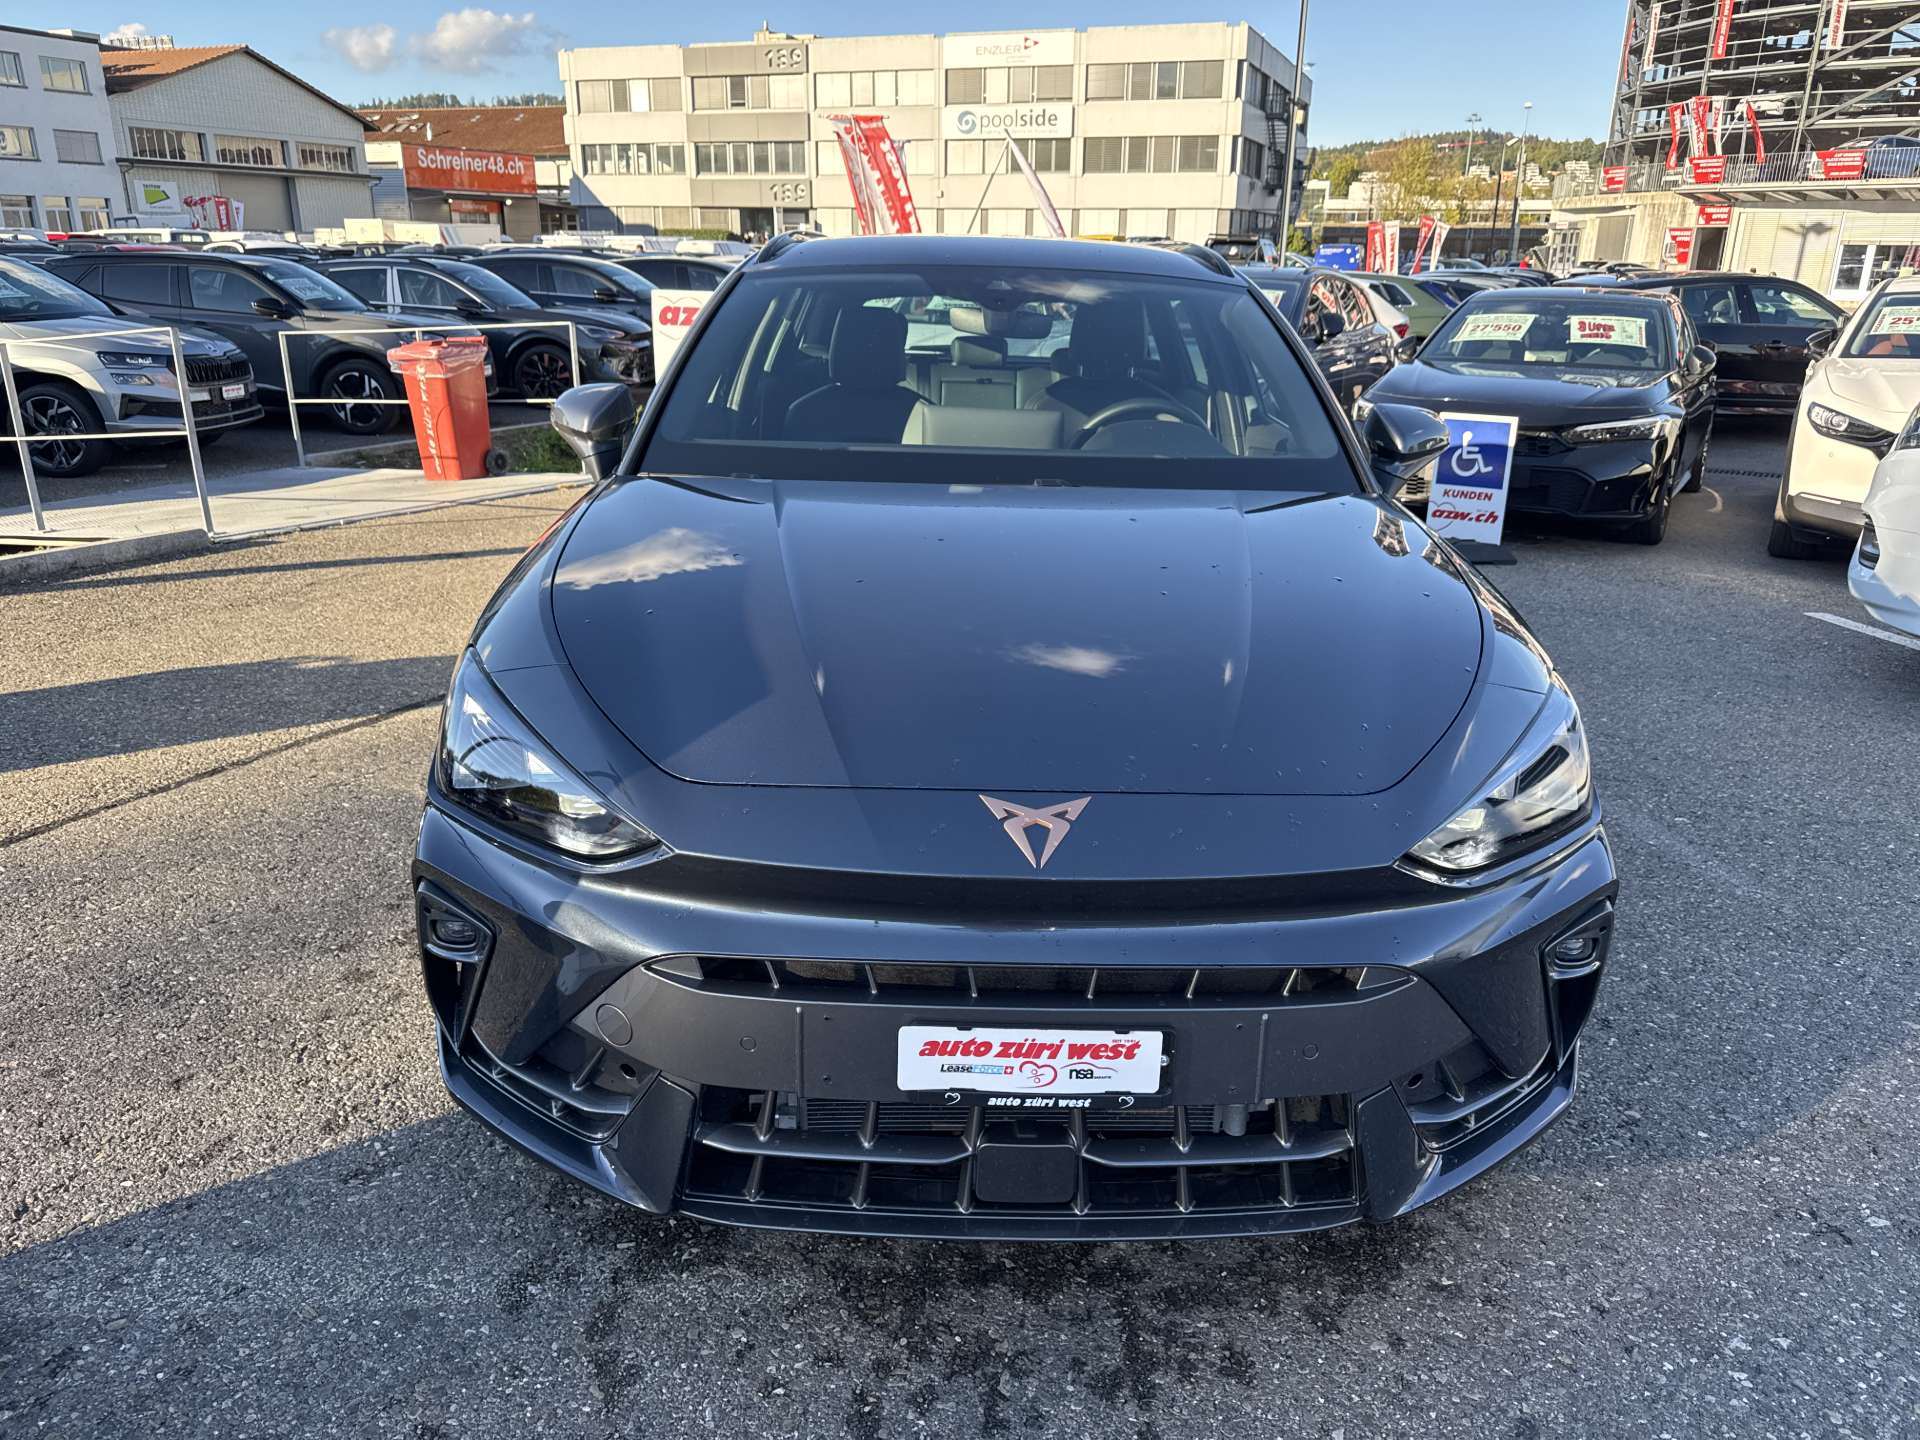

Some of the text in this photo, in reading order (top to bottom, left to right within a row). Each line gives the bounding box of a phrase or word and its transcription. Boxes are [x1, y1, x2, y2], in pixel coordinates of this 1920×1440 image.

[975, 44, 1022, 56] ENZLER
[765, 48, 802, 68] 139
[980, 109, 1058, 134] poolside
[417, 148, 524, 175] Schreiner48.ch
[770, 183, 806, 203] 139
[1471, 324, 1522, 332] 27'550
[1443, 489, 1493, 501] KUNDEN
[1432, 509, 1498, 523] azw.ch
[918, 1037, 1141, 1060] auto züri west
[1069, 1069, 1094, 1079] nsa
[988, 1097, 1092, 1108] auto züri west
